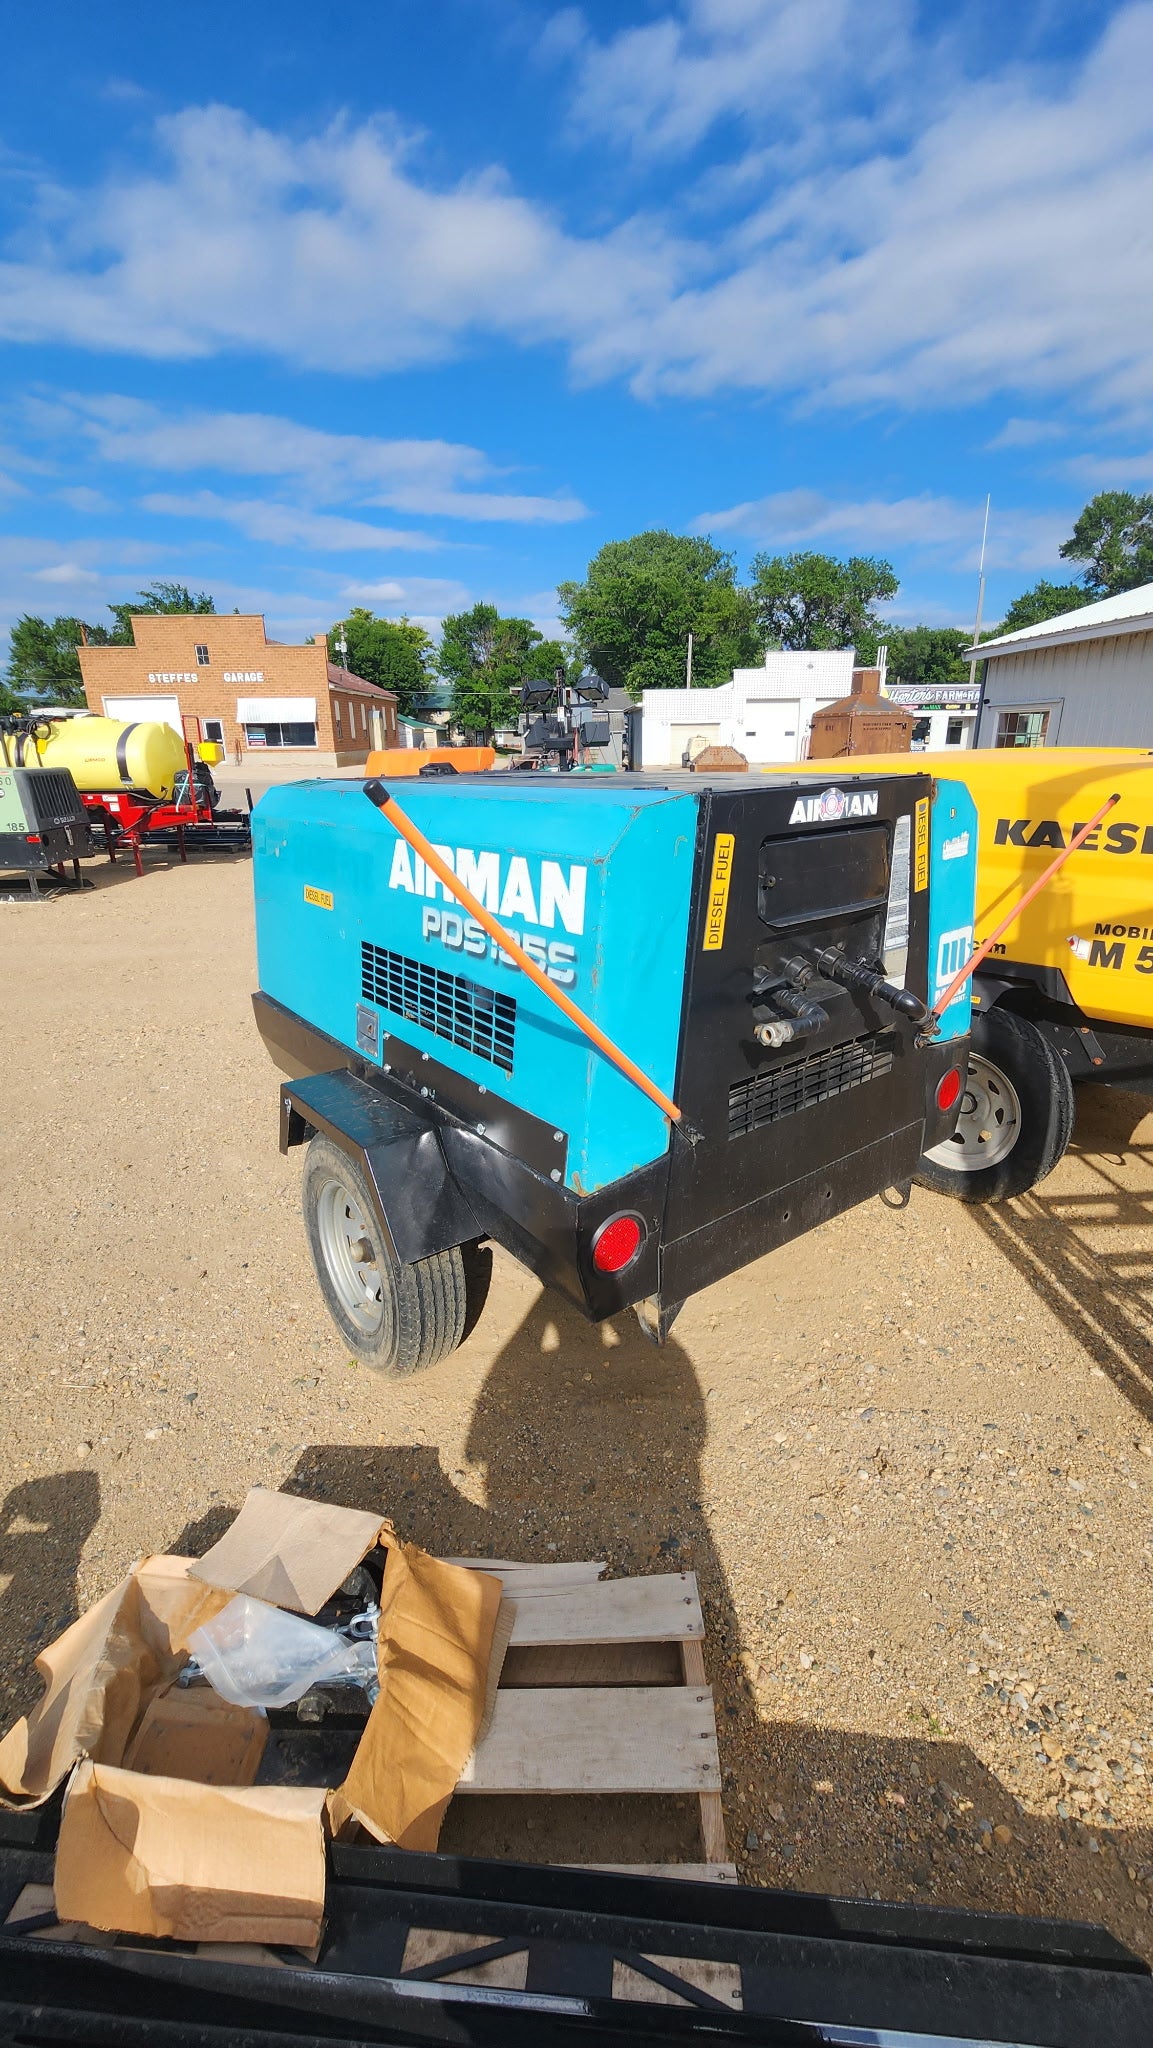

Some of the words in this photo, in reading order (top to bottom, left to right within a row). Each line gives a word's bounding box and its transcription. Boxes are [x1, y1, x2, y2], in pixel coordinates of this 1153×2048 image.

[148, 673, 199, 684] STEFFES
[223, 672, 265, 683] GARAGE
[889, 687, 935, 704] Horter's
[935, 689, 963, 701] FARM
[788, 792, 879, 825] AIRAN
[6, 822, 26, 832] 185
[917, 803, 927, 850] DIESEL
[716, 840, 732, 881] FUEL
[917, 855, 927, 888] FUEL
[305, 888, 320, 902] DIESEL
[320, 893, 332, 907] FUEL
[388, 838, 588, 935] AIRMAN
[708, 887, 726, 945] DIESEL
[972, 937, 1006, 955] cm
[1088, 939, 1126, 970] M
